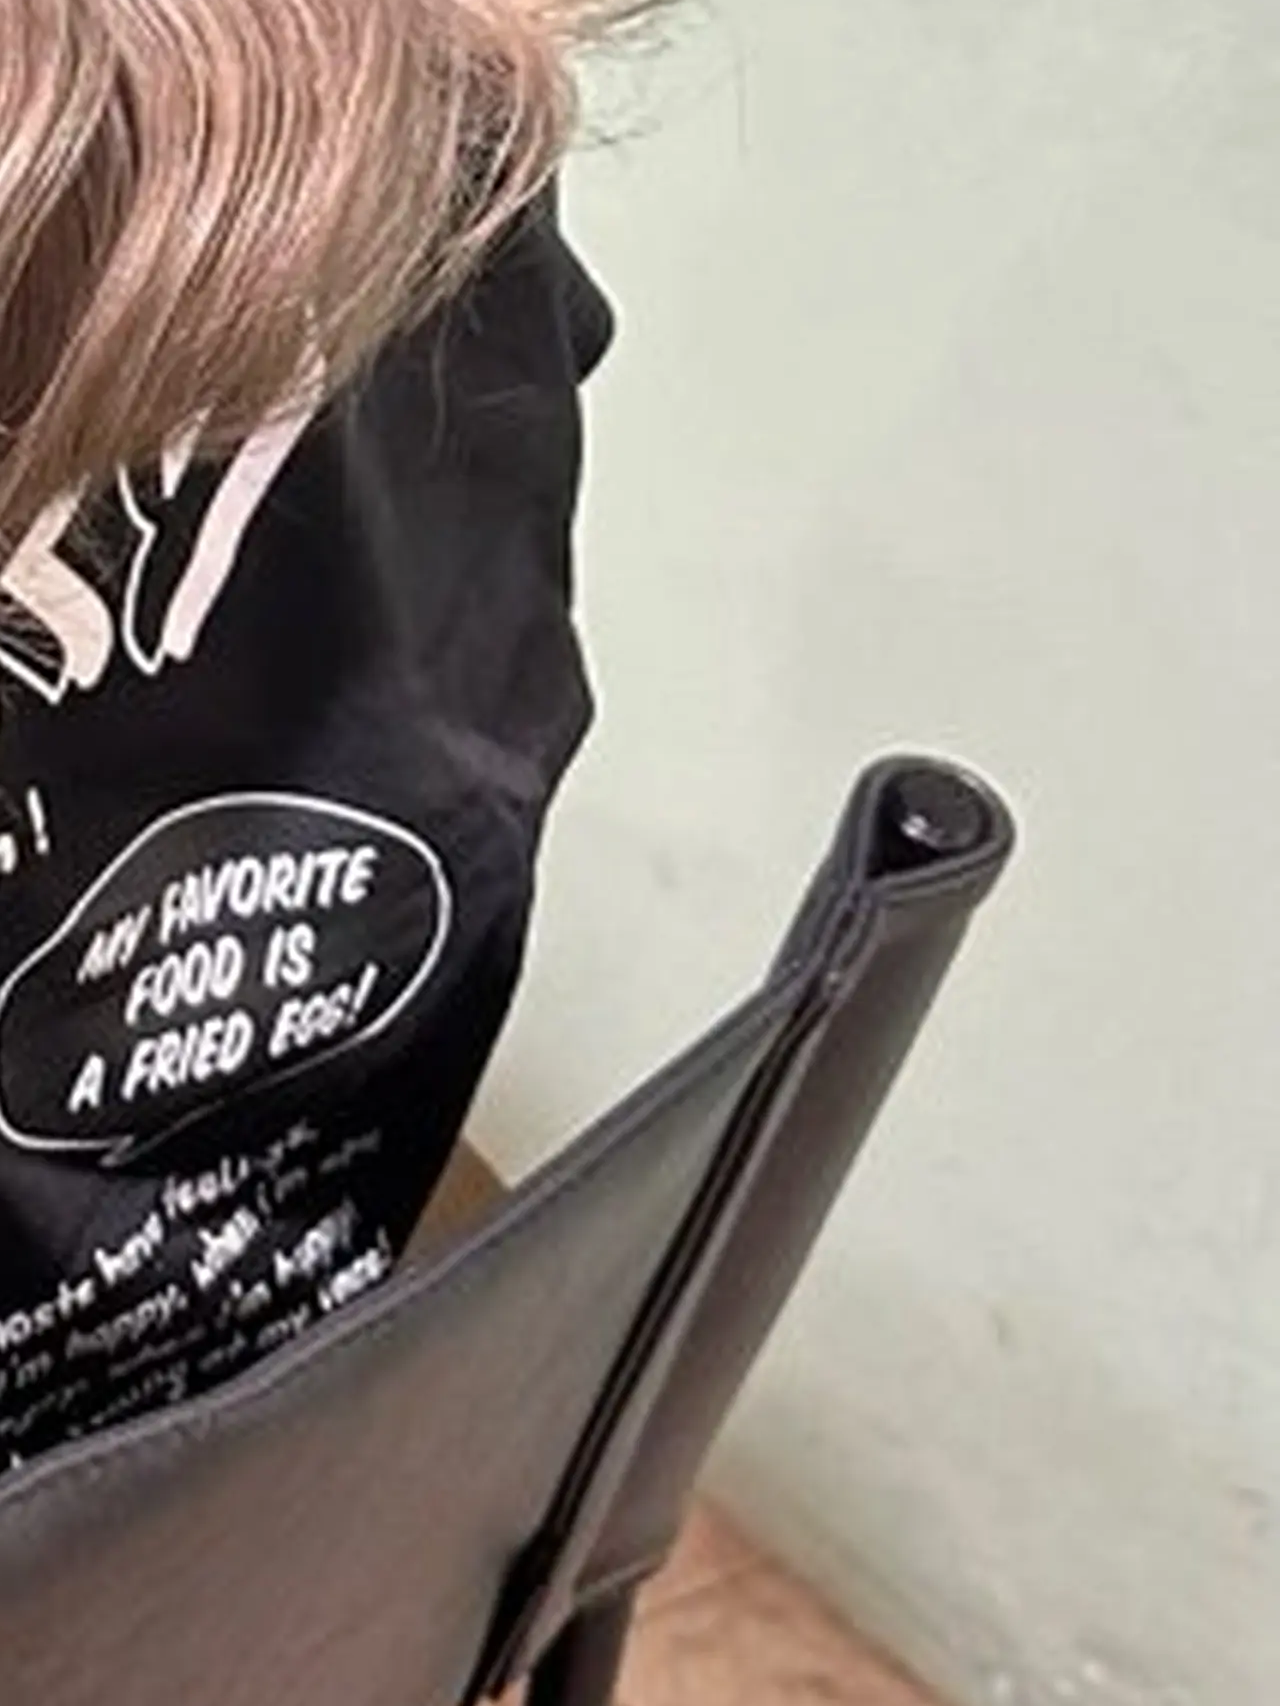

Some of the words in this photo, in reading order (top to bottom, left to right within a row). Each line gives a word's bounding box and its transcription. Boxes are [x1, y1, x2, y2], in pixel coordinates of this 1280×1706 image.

[76, 905, 151, 984] MY
[159, 846, 379, 946] FAVORITE
[125, 933, 246, 1026] FOOD
[263, 922, 316, 988] IS
[67, 1053, 106, 1114] A
[121, 1010, 255, 1101] FRIED
